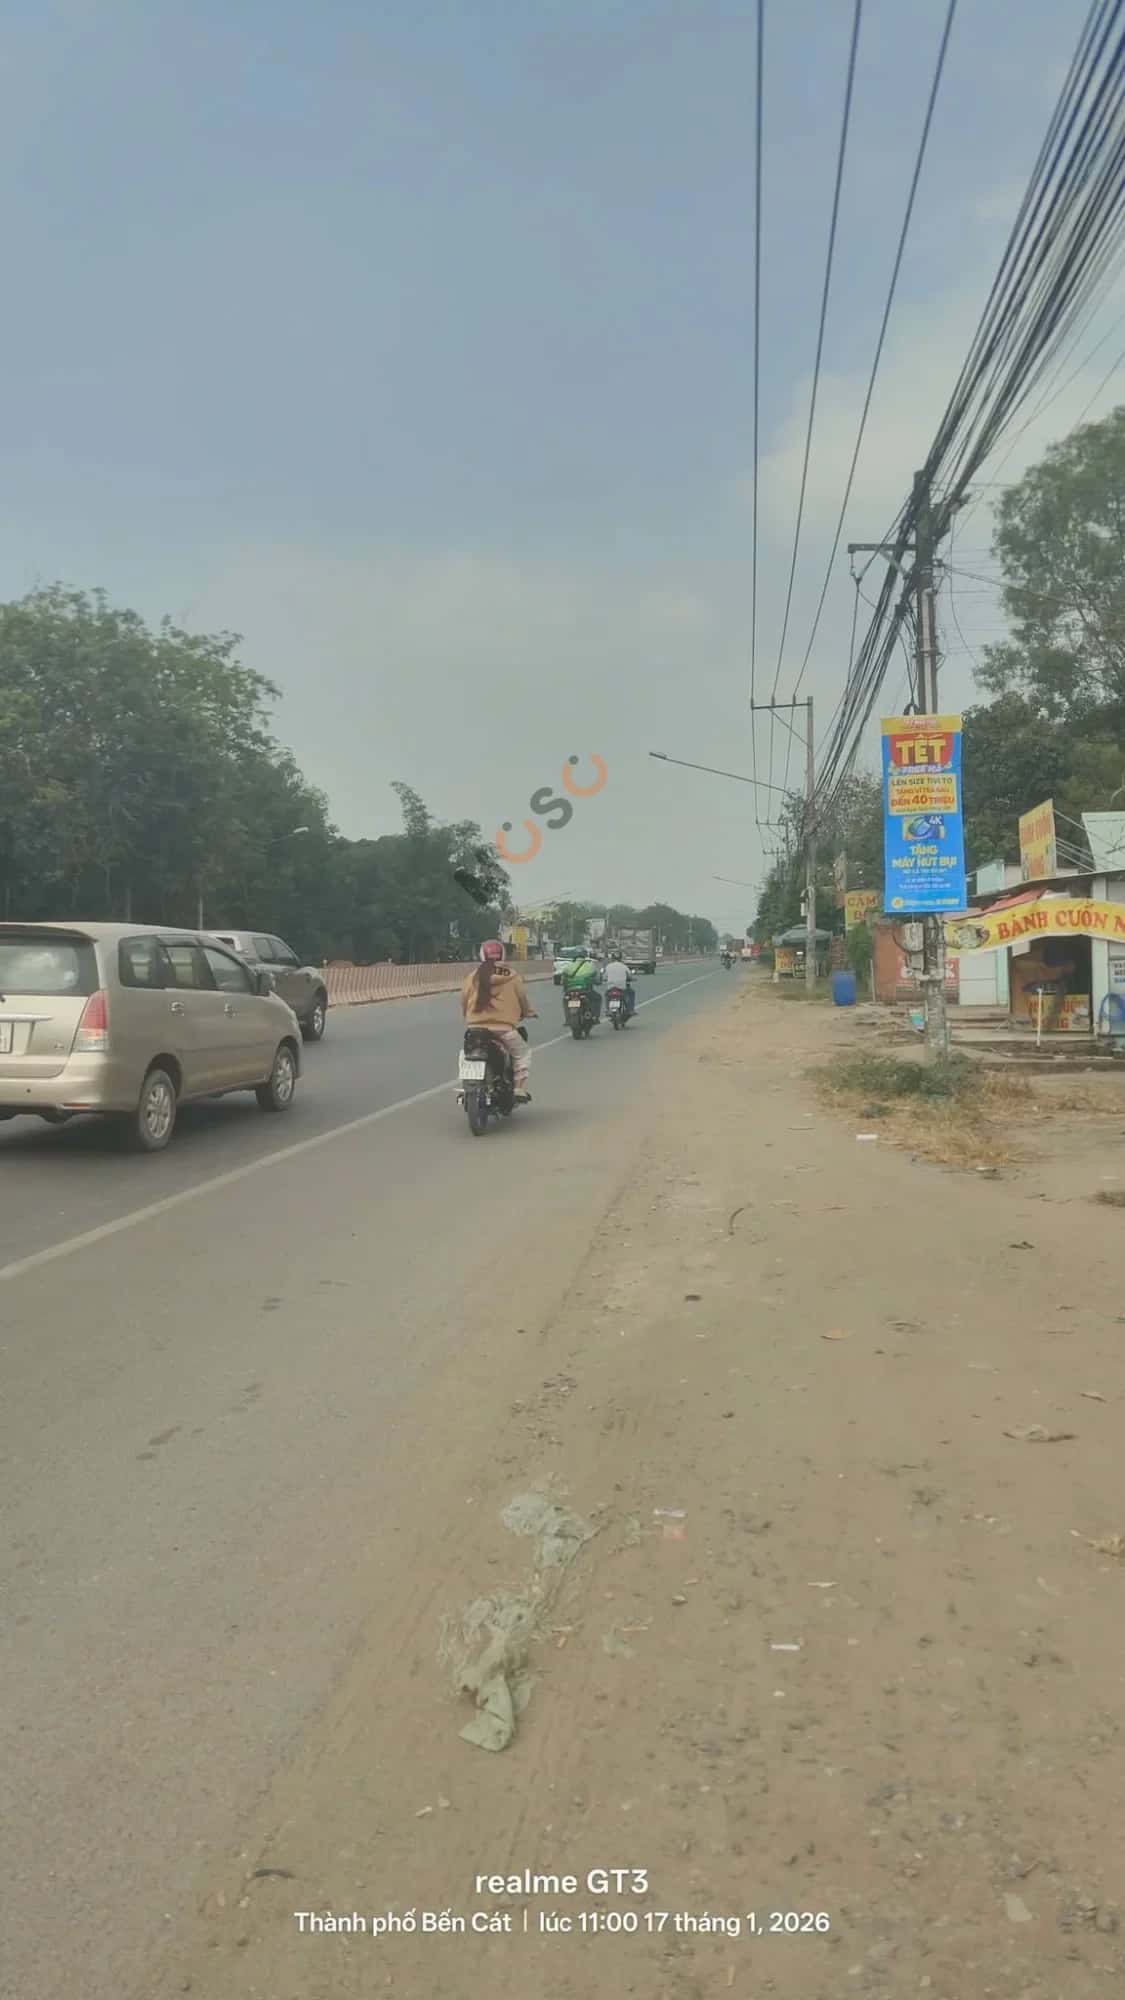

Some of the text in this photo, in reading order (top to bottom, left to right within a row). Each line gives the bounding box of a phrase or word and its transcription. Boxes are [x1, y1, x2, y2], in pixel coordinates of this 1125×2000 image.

[896, 733, 946, 765] TẾT
[909, 776, 925, 786] SIZE
[911, 794, 928, 805] 40
[928, 815, 943, 825] 4K
[892, 856, 916, 868] MÁY
[1055, 902, 1109, 929] CUỐN
